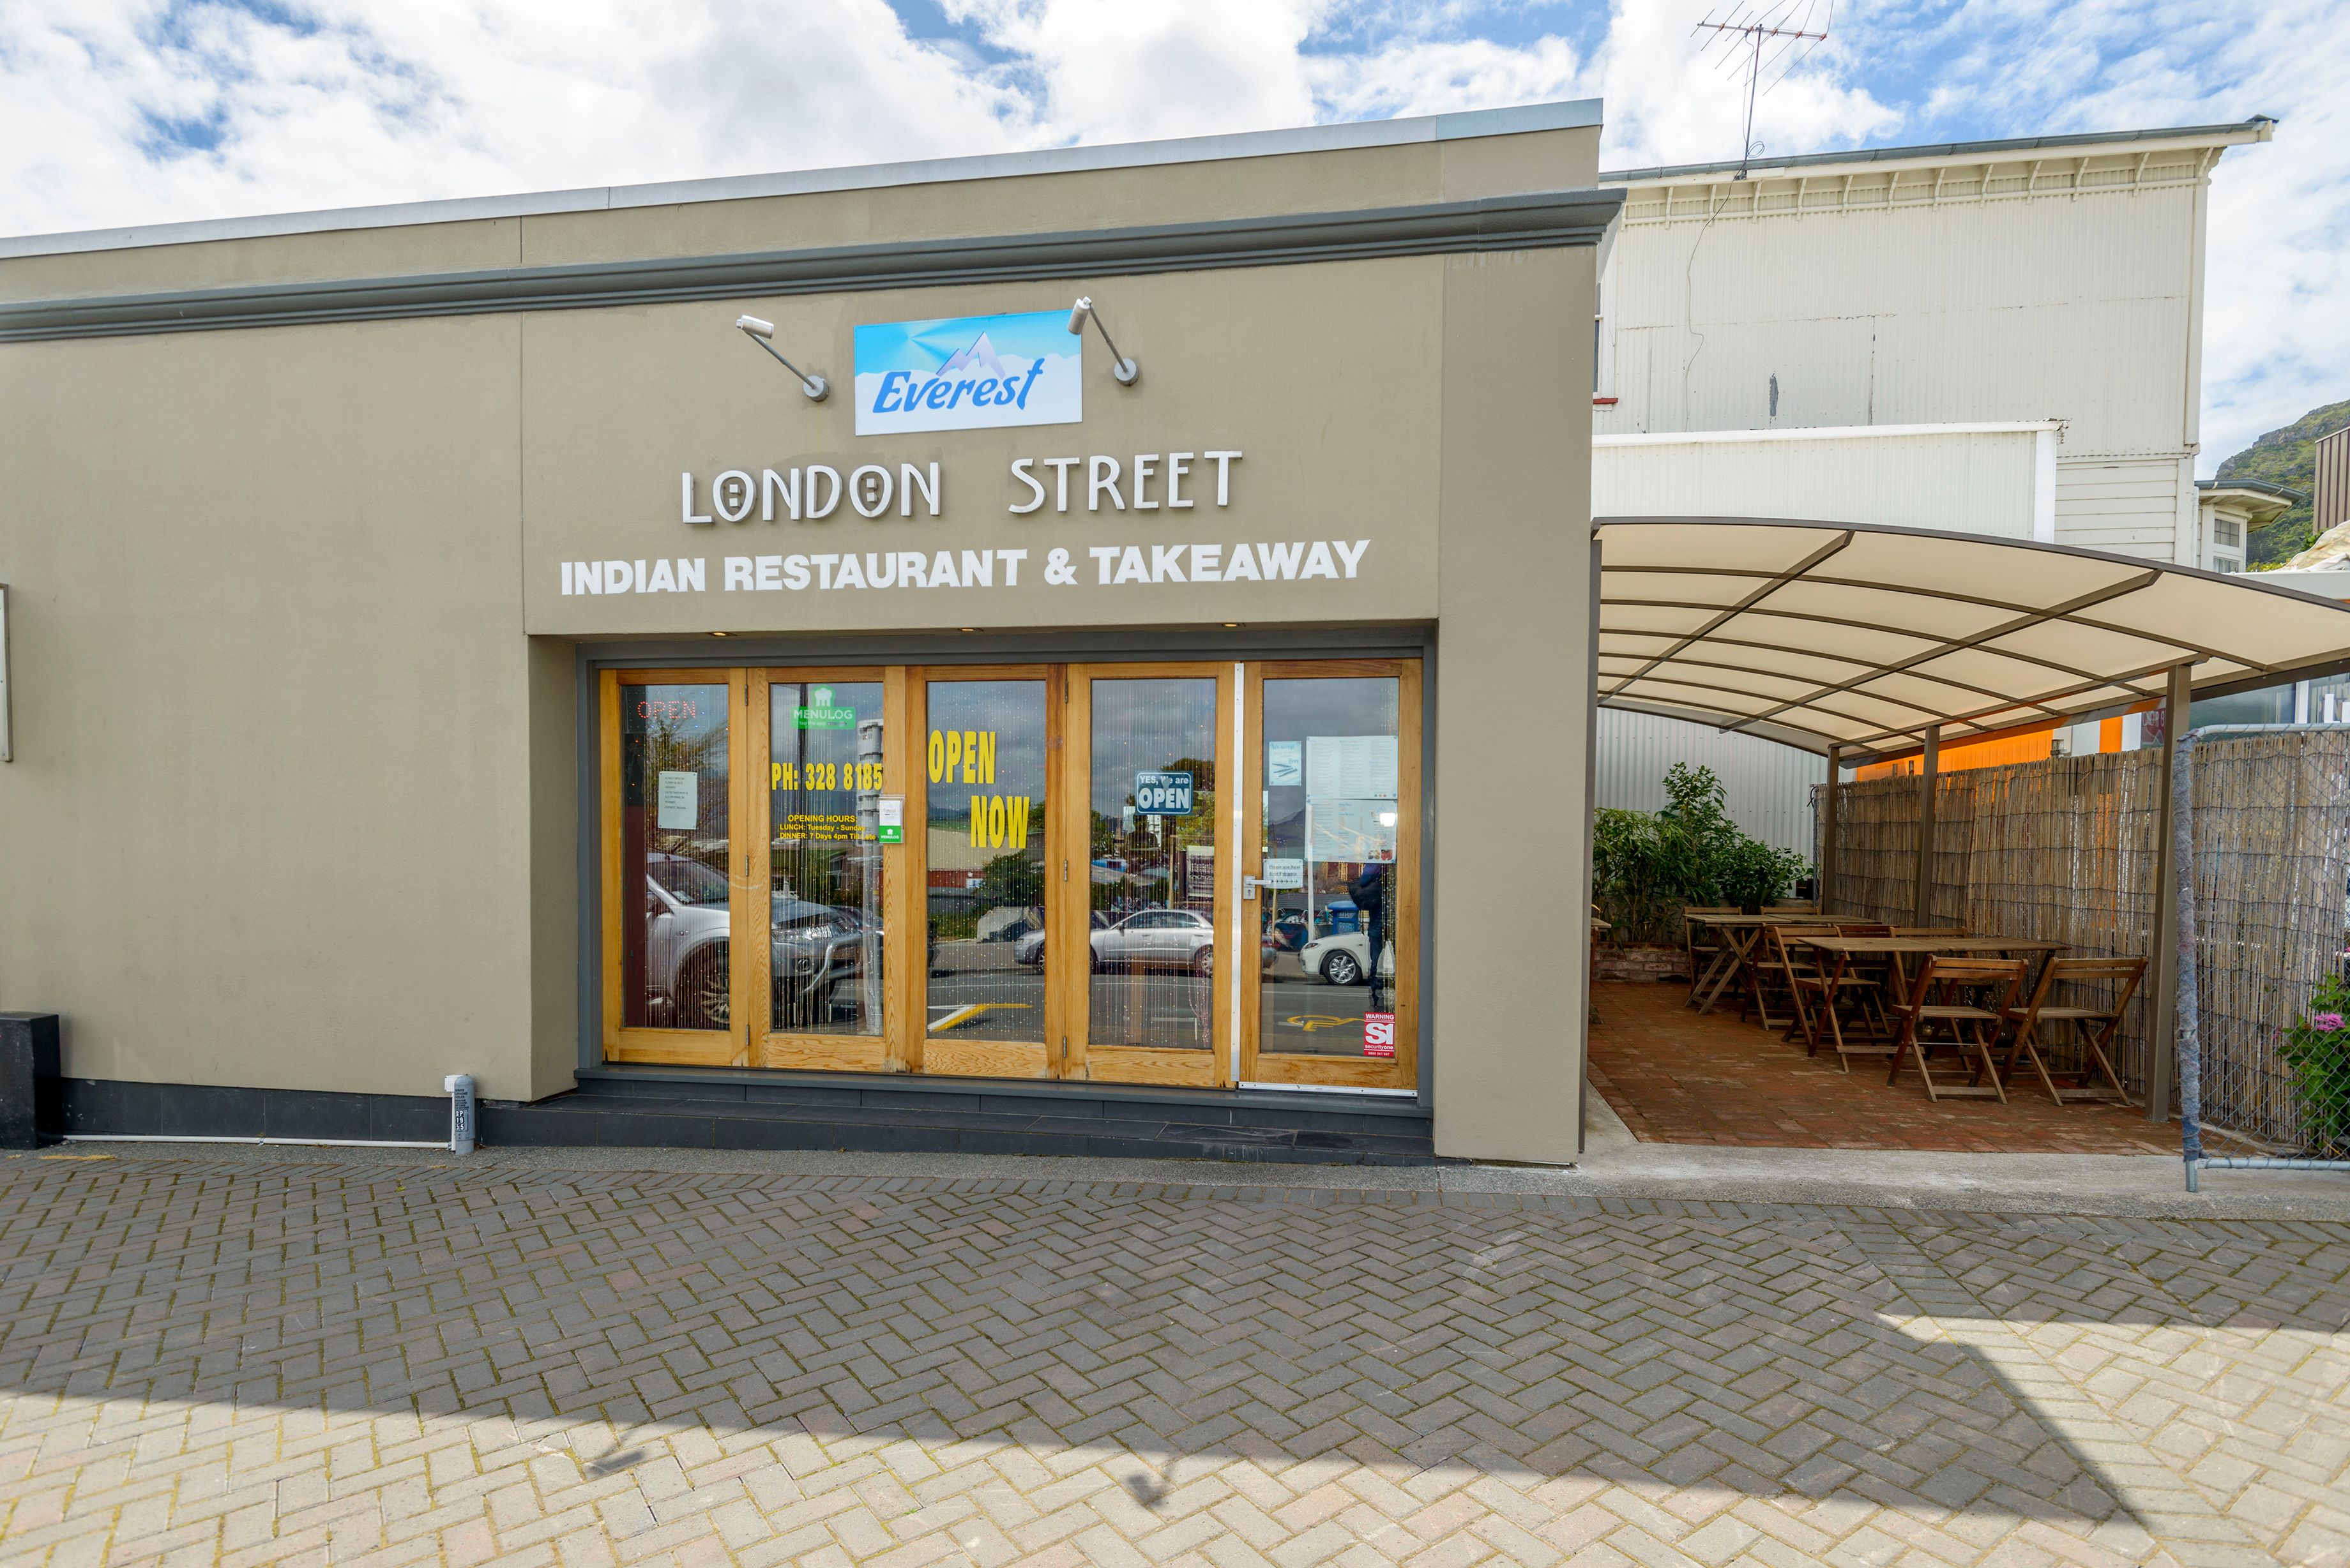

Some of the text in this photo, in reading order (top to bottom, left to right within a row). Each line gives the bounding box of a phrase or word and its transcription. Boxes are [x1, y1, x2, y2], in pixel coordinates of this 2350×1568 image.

[872, 358, 1045, 414] Everest
[681, 450, 1243, 524] LONDON STREET
[561, 539, 1371, 595] INDIAN RESTAURANT & TAKEAWAY
[637, 700, 696, 720] OPEN
[793, 709, 853, 720] MENULOG
[771, 762, 883, 790] PH: 328 8185
[928, 730, 996, 785] OPEN
[1139, 776, 1158, 785] YES,
[1139, 787, 1190, 809] OPEN
[971, 795, 1030, 848] NOW
